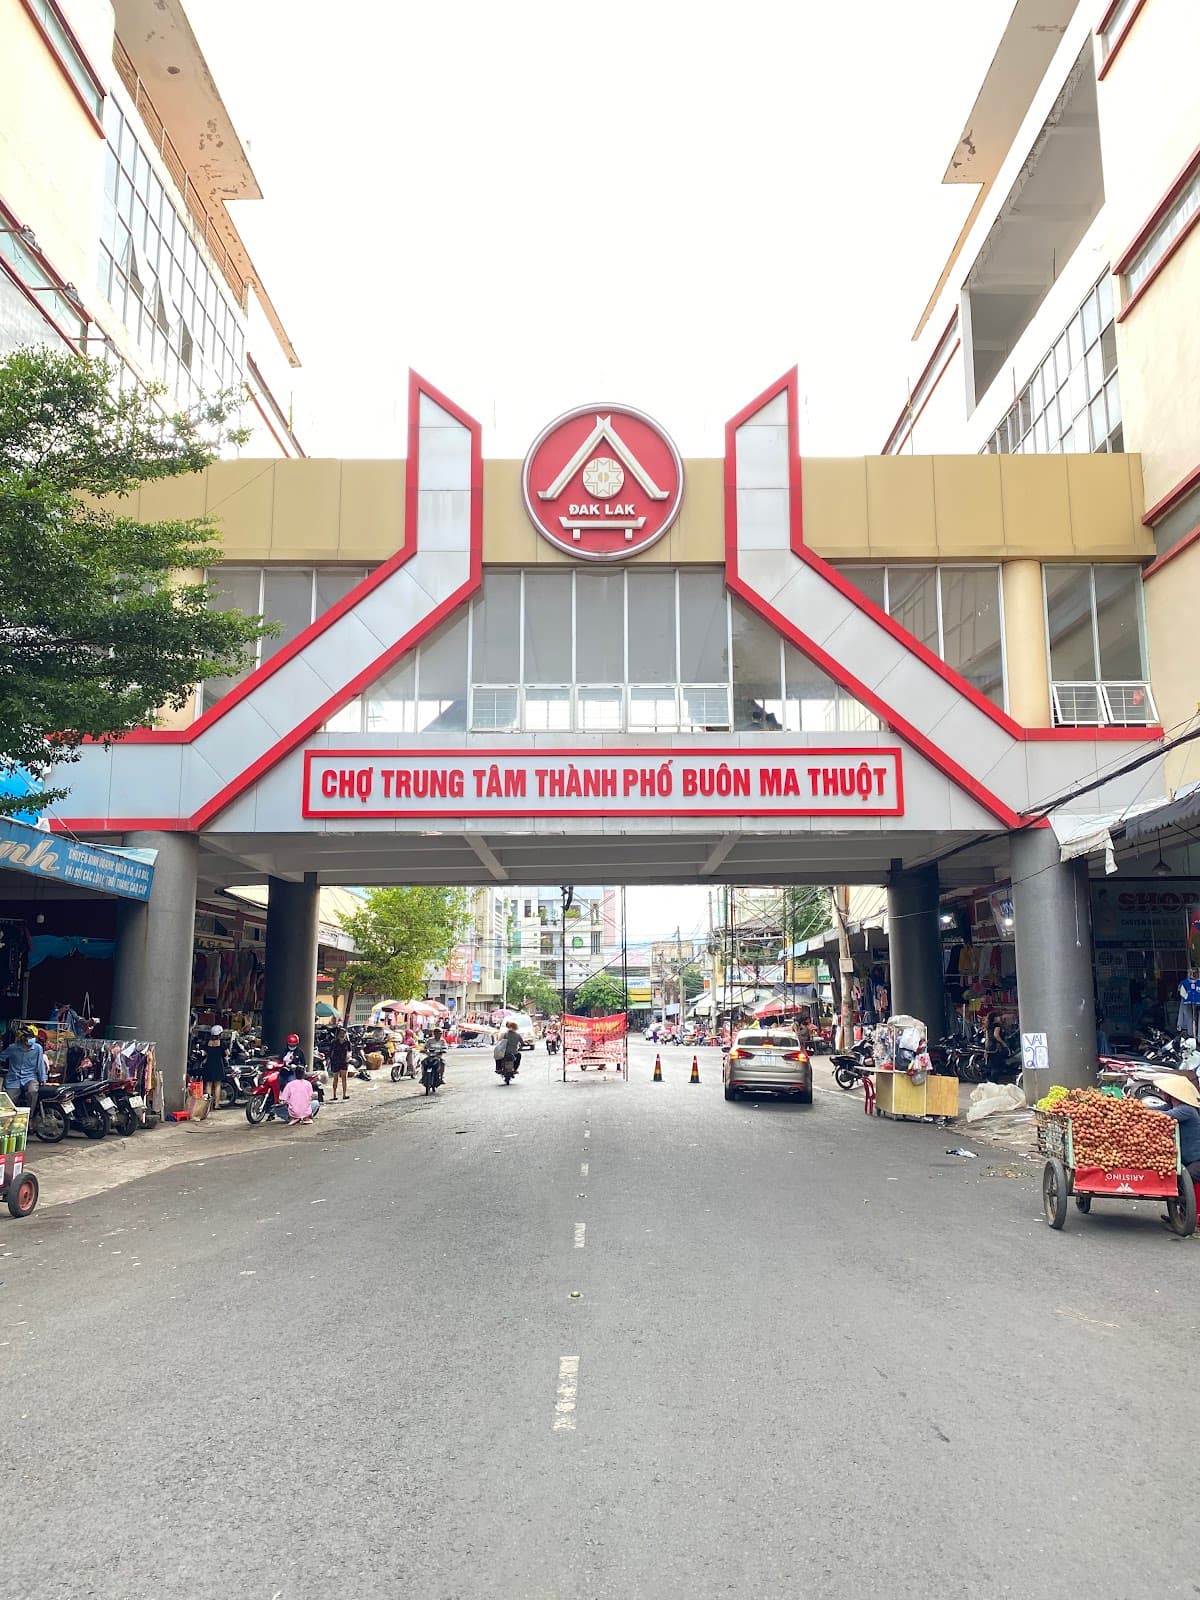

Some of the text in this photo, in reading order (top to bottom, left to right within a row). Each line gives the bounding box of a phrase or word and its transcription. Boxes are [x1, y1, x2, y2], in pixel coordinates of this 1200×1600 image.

[604, 503, 635, 515] LAK
[321, 759, 887, 803] CHỢ TRUNG TÂM THÀNH PHỐ BUÔN MA THUỘT
[0, 838, 60, 871] nh
[1105, 1173, 1145, 1183] ARISTINO
